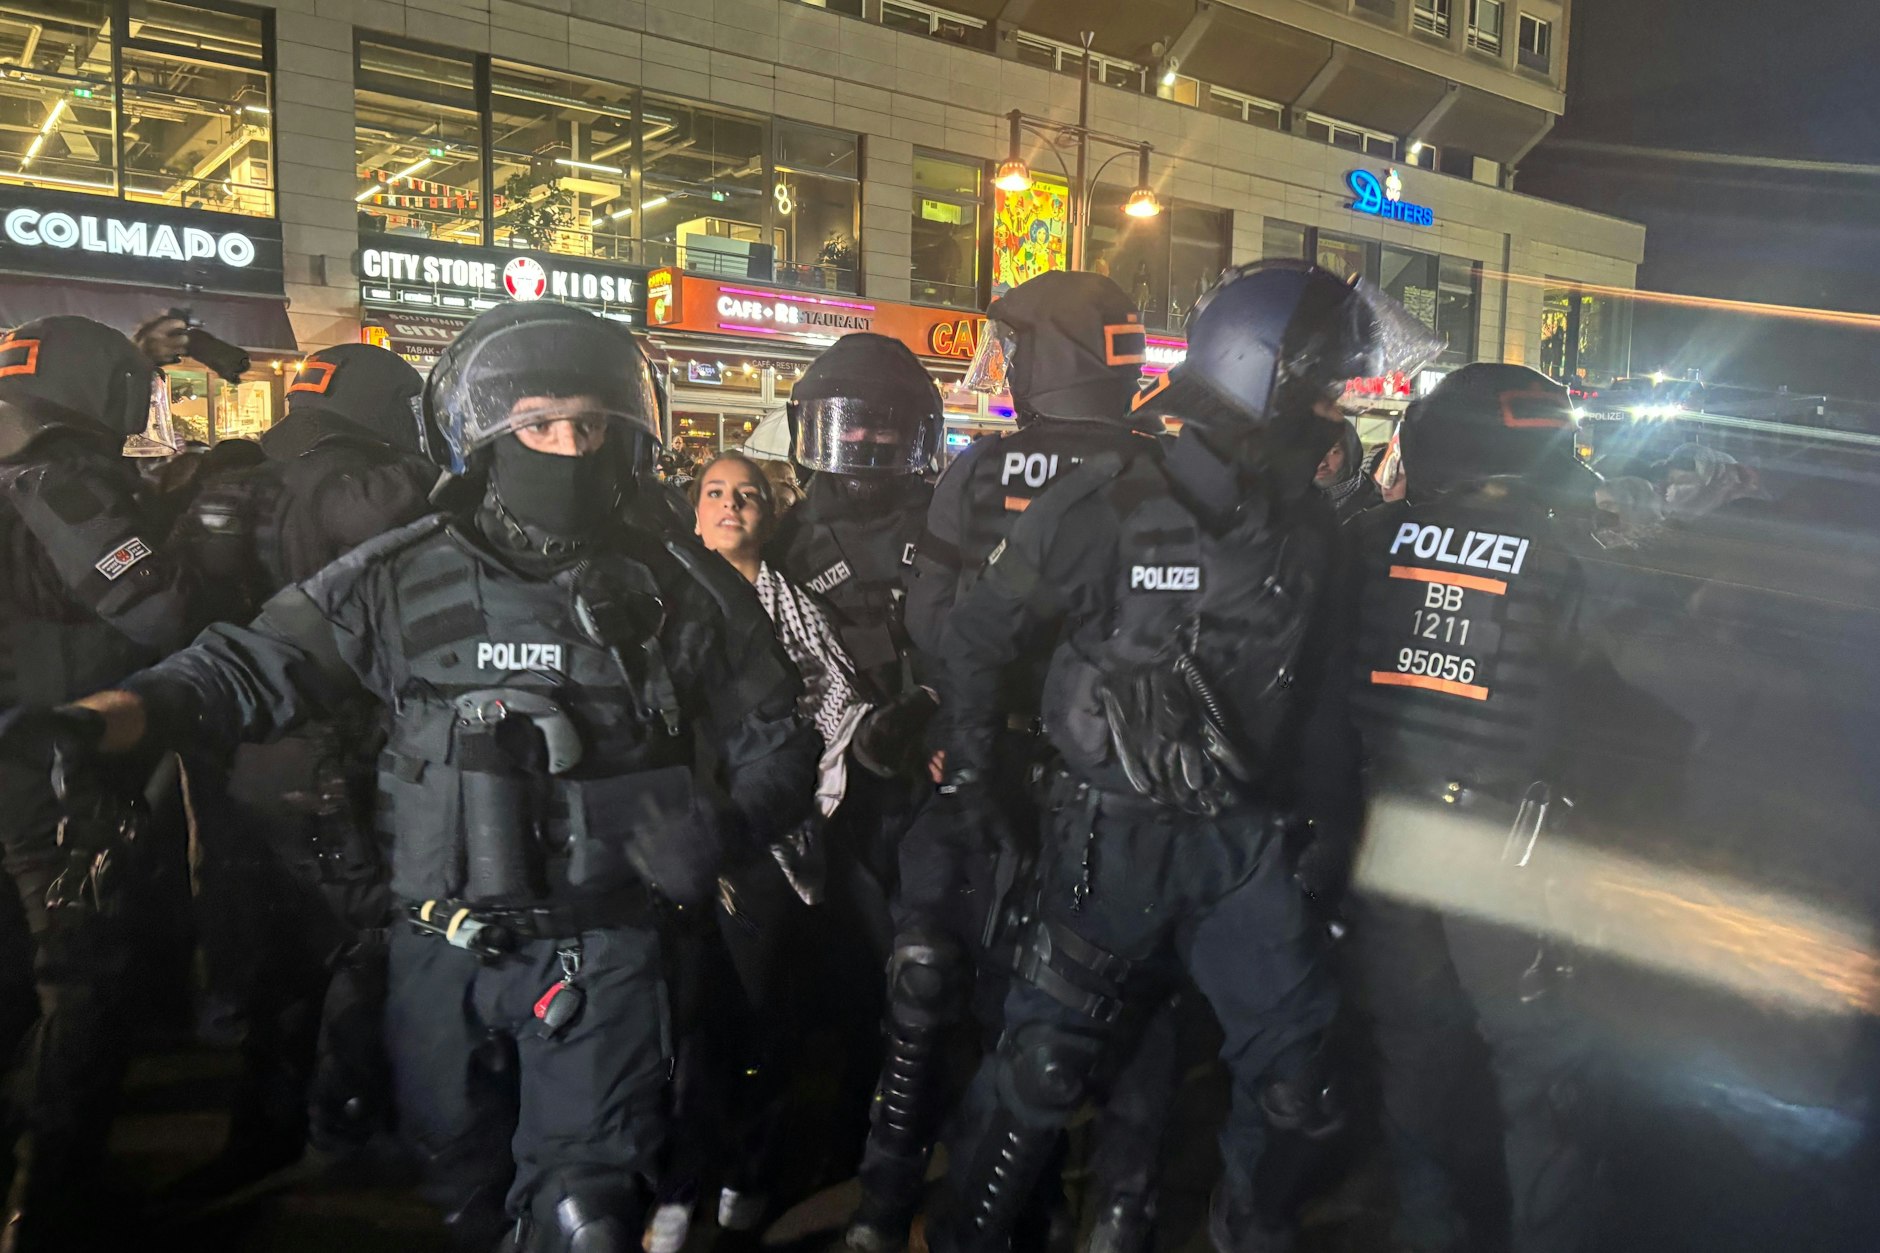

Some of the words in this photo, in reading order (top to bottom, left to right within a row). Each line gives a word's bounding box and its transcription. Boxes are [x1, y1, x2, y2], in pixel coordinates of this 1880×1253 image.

[1350, 169, 1433, 226] DEITERS
[5, 208, 255, 267] COLMADO
[363, 249, 419, 281] CITY
[423, 255, 496, 289] STORE
[552, 270, 633, 303] KIOSK
[395, 324, 448, 338] CITY
[774, 302, 873, 331] RESTAURANT
[406, 346, 434, 354] TABAK
[776, 361, 810, 370] RESTAUR
[1588, 411, 1625, 421] POLIZEI
[1389, 522, 1530, 575] POLIZEI
[1131, 565, 1200, 590] POLIZEI
[1424, 582, 1464, 611] BB
[1412, 610, 1470, 645] 1211
[477, 642, 562, 671] POLIZEI
[1397, 647, 1476, 683] 95056
